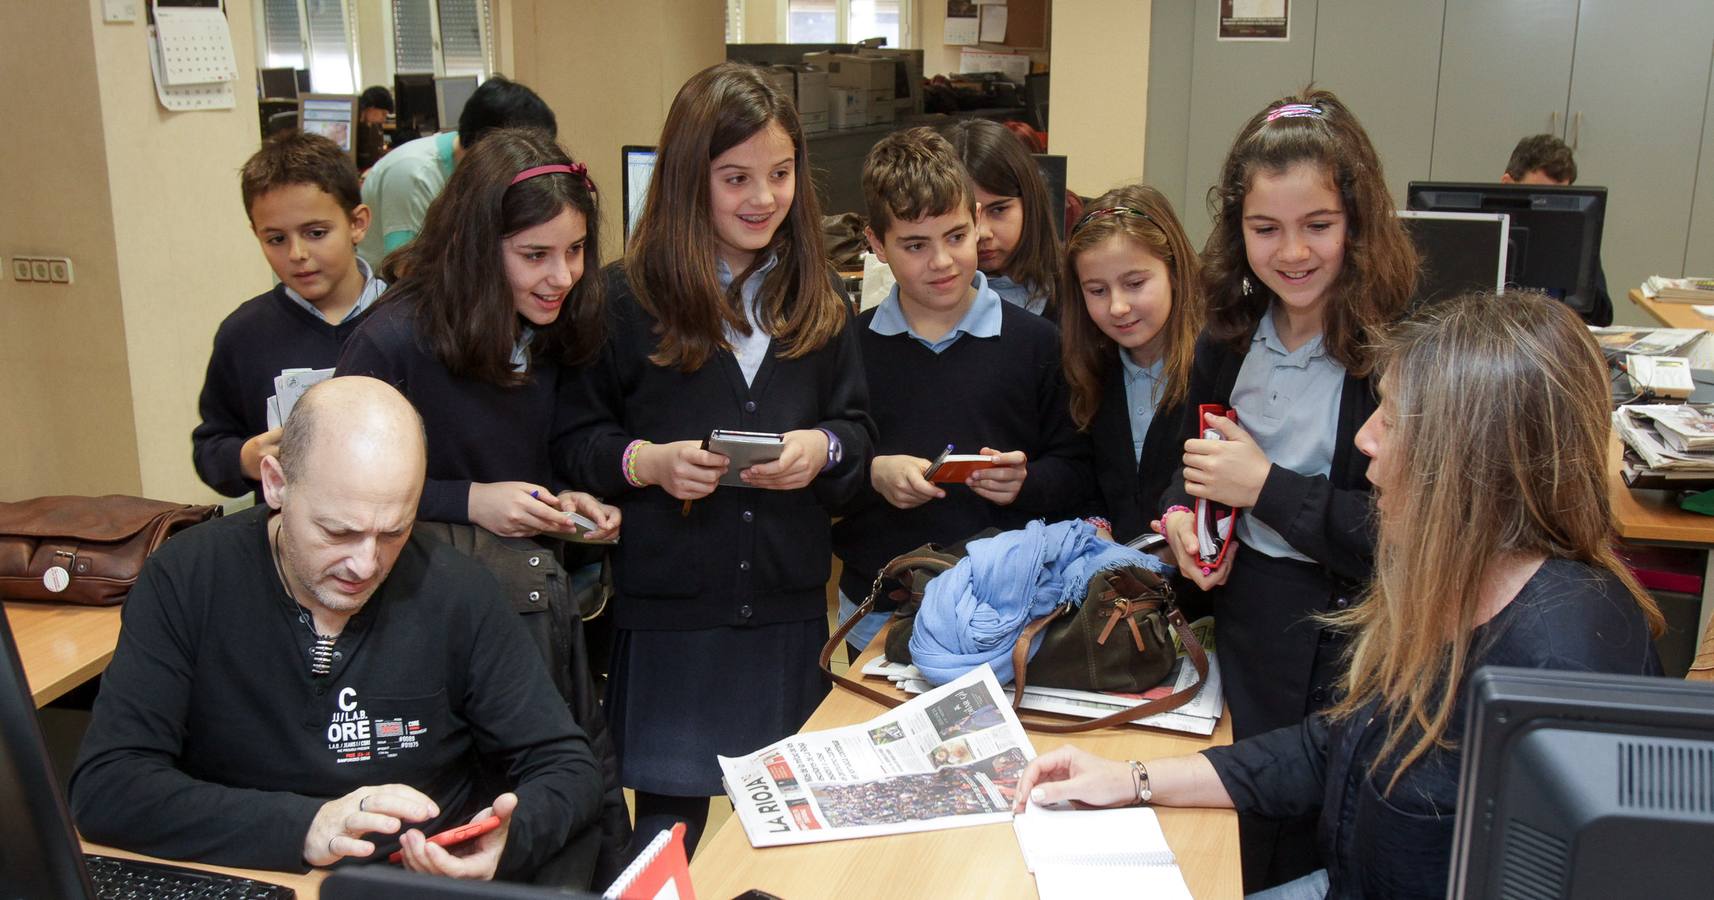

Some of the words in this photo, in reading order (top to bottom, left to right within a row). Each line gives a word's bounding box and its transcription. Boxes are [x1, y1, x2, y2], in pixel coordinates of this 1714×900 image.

[338, 687, 357, 712] C
[328, 720, 371, 742] ORE
[744, 776, 781, 815] RIOJA
[766, 815, 792, 834] LA
